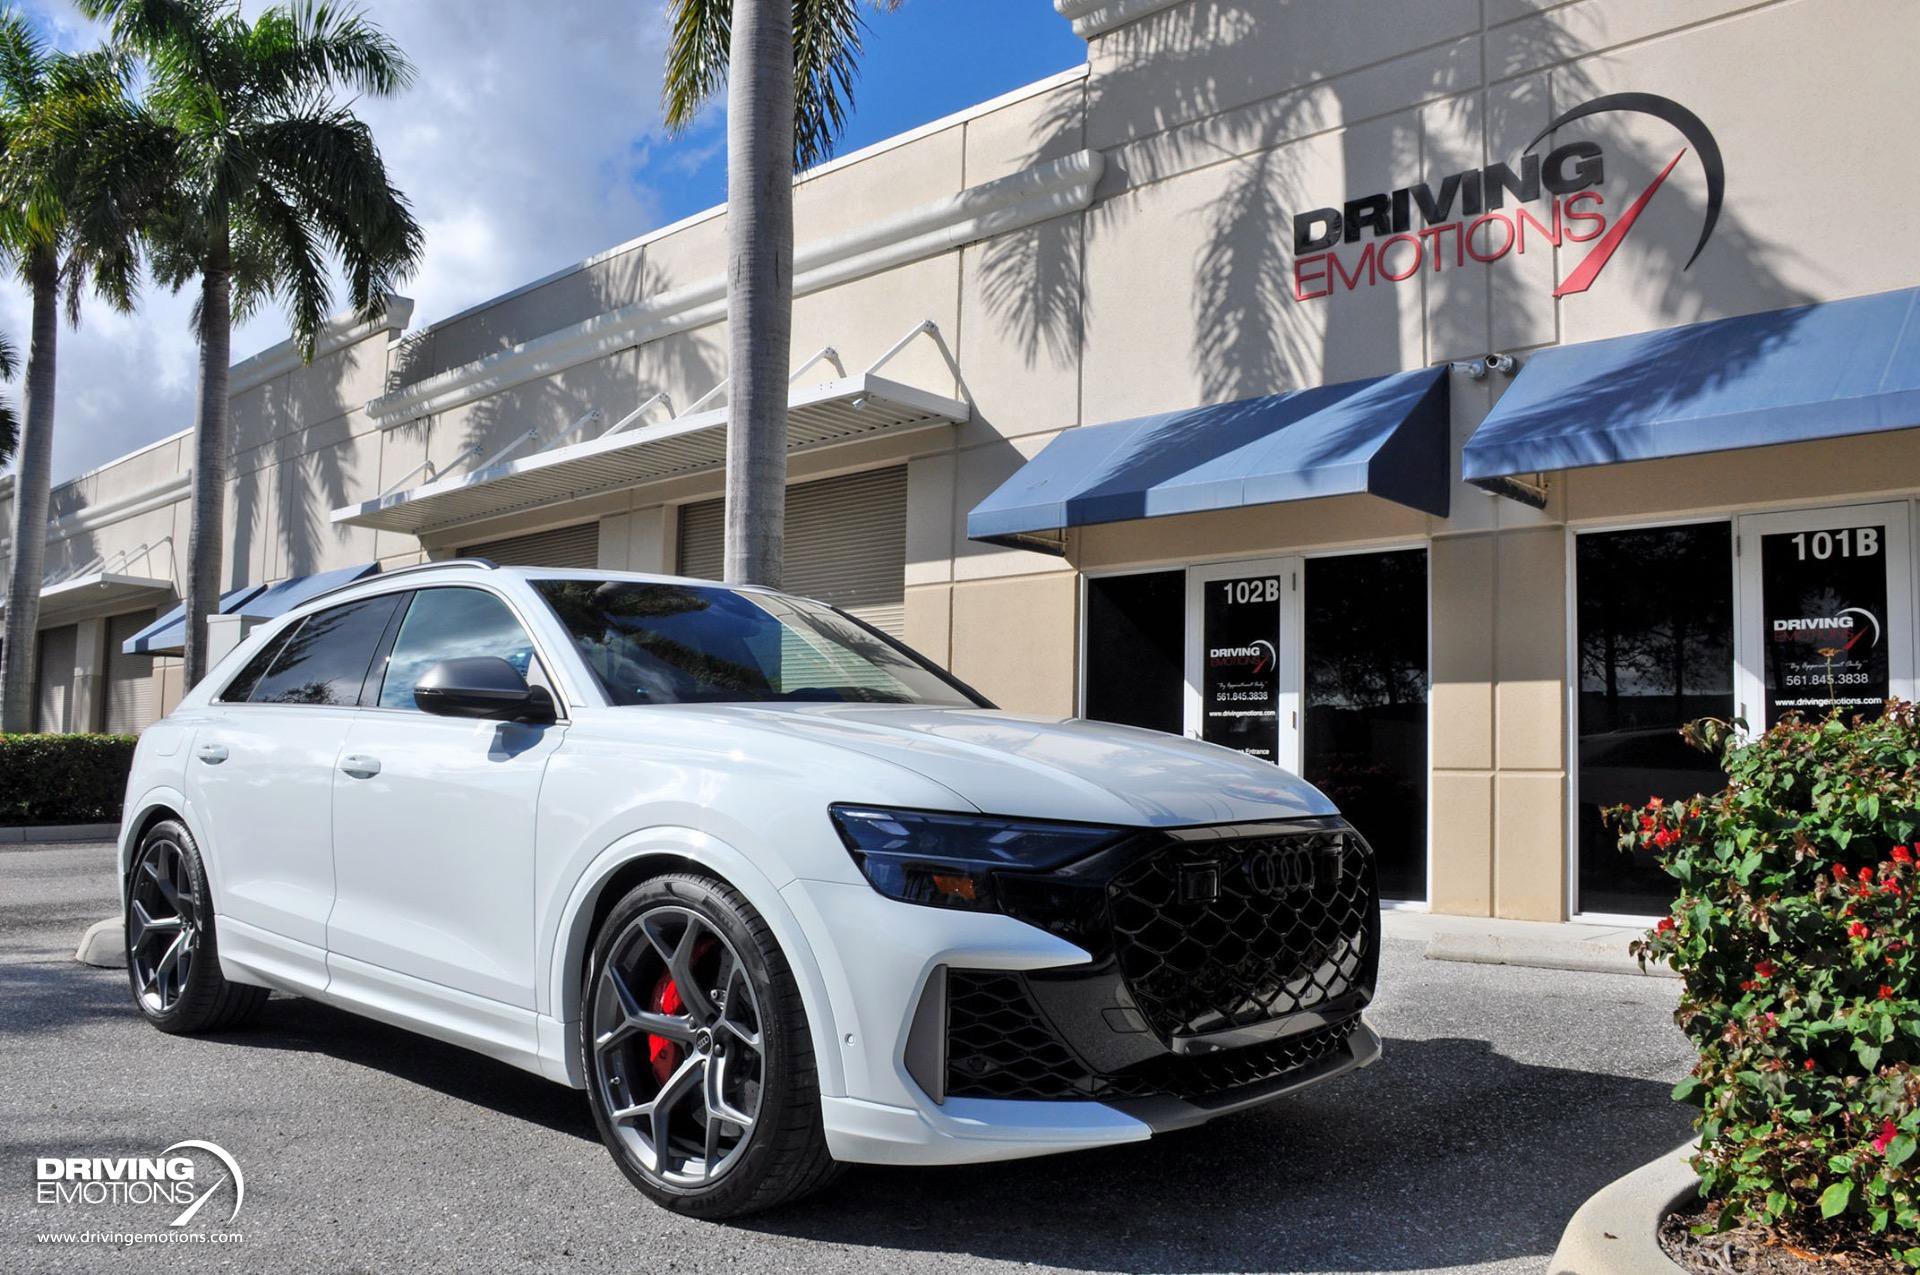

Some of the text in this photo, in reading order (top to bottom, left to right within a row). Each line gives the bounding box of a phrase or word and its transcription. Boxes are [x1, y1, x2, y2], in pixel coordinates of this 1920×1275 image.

[1294, 141, 1604, 256] DRIVING
[1294, 191, 1607, 301] EMOTIONS
[1791, 528, 1879, 561] 101B
[1224, 579, 1279, 604] 102B
[1774, 616, 1854, 631] DRIVING
[1210, 647, 1260, 658] DRIVING
[1786, 673, 1869, 686] 561.845.3838
[1216, 691, 1269, 702] 561.845.3838
[1775, 697, 1882, 707] www.drivingemotions.com
[1209, 709, 1276, 718] www.drivingemotions.com
